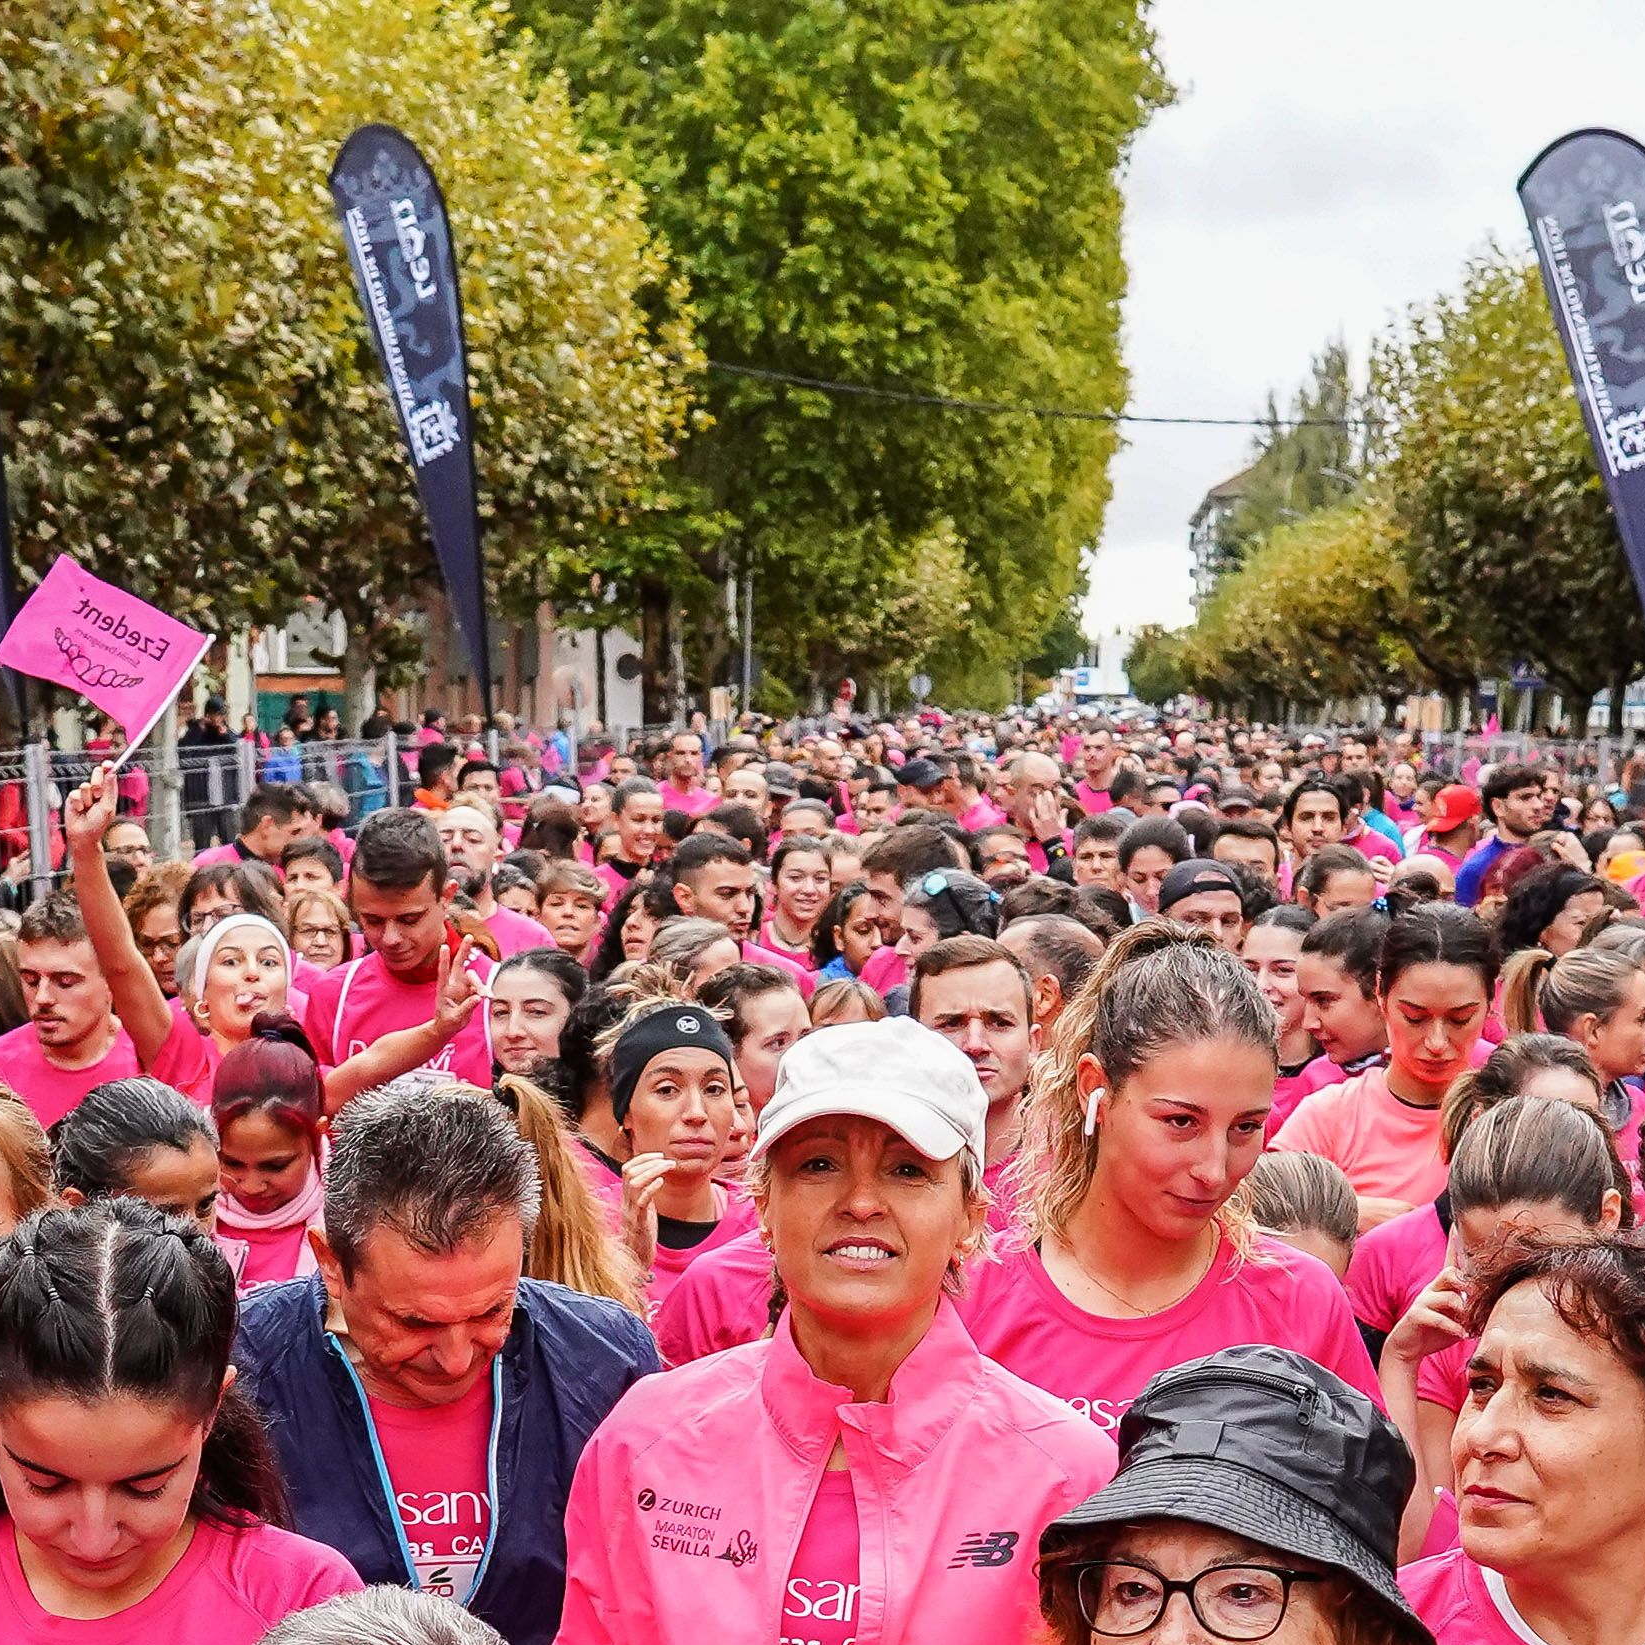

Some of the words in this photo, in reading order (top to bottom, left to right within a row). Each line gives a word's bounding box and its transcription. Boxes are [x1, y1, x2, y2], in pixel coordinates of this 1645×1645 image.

[658, 1498, 722, 1520] ZURICH
[654, 1520, 716, 1541] MARATON
[651, 1534, 711, 1557] SEVILLA
